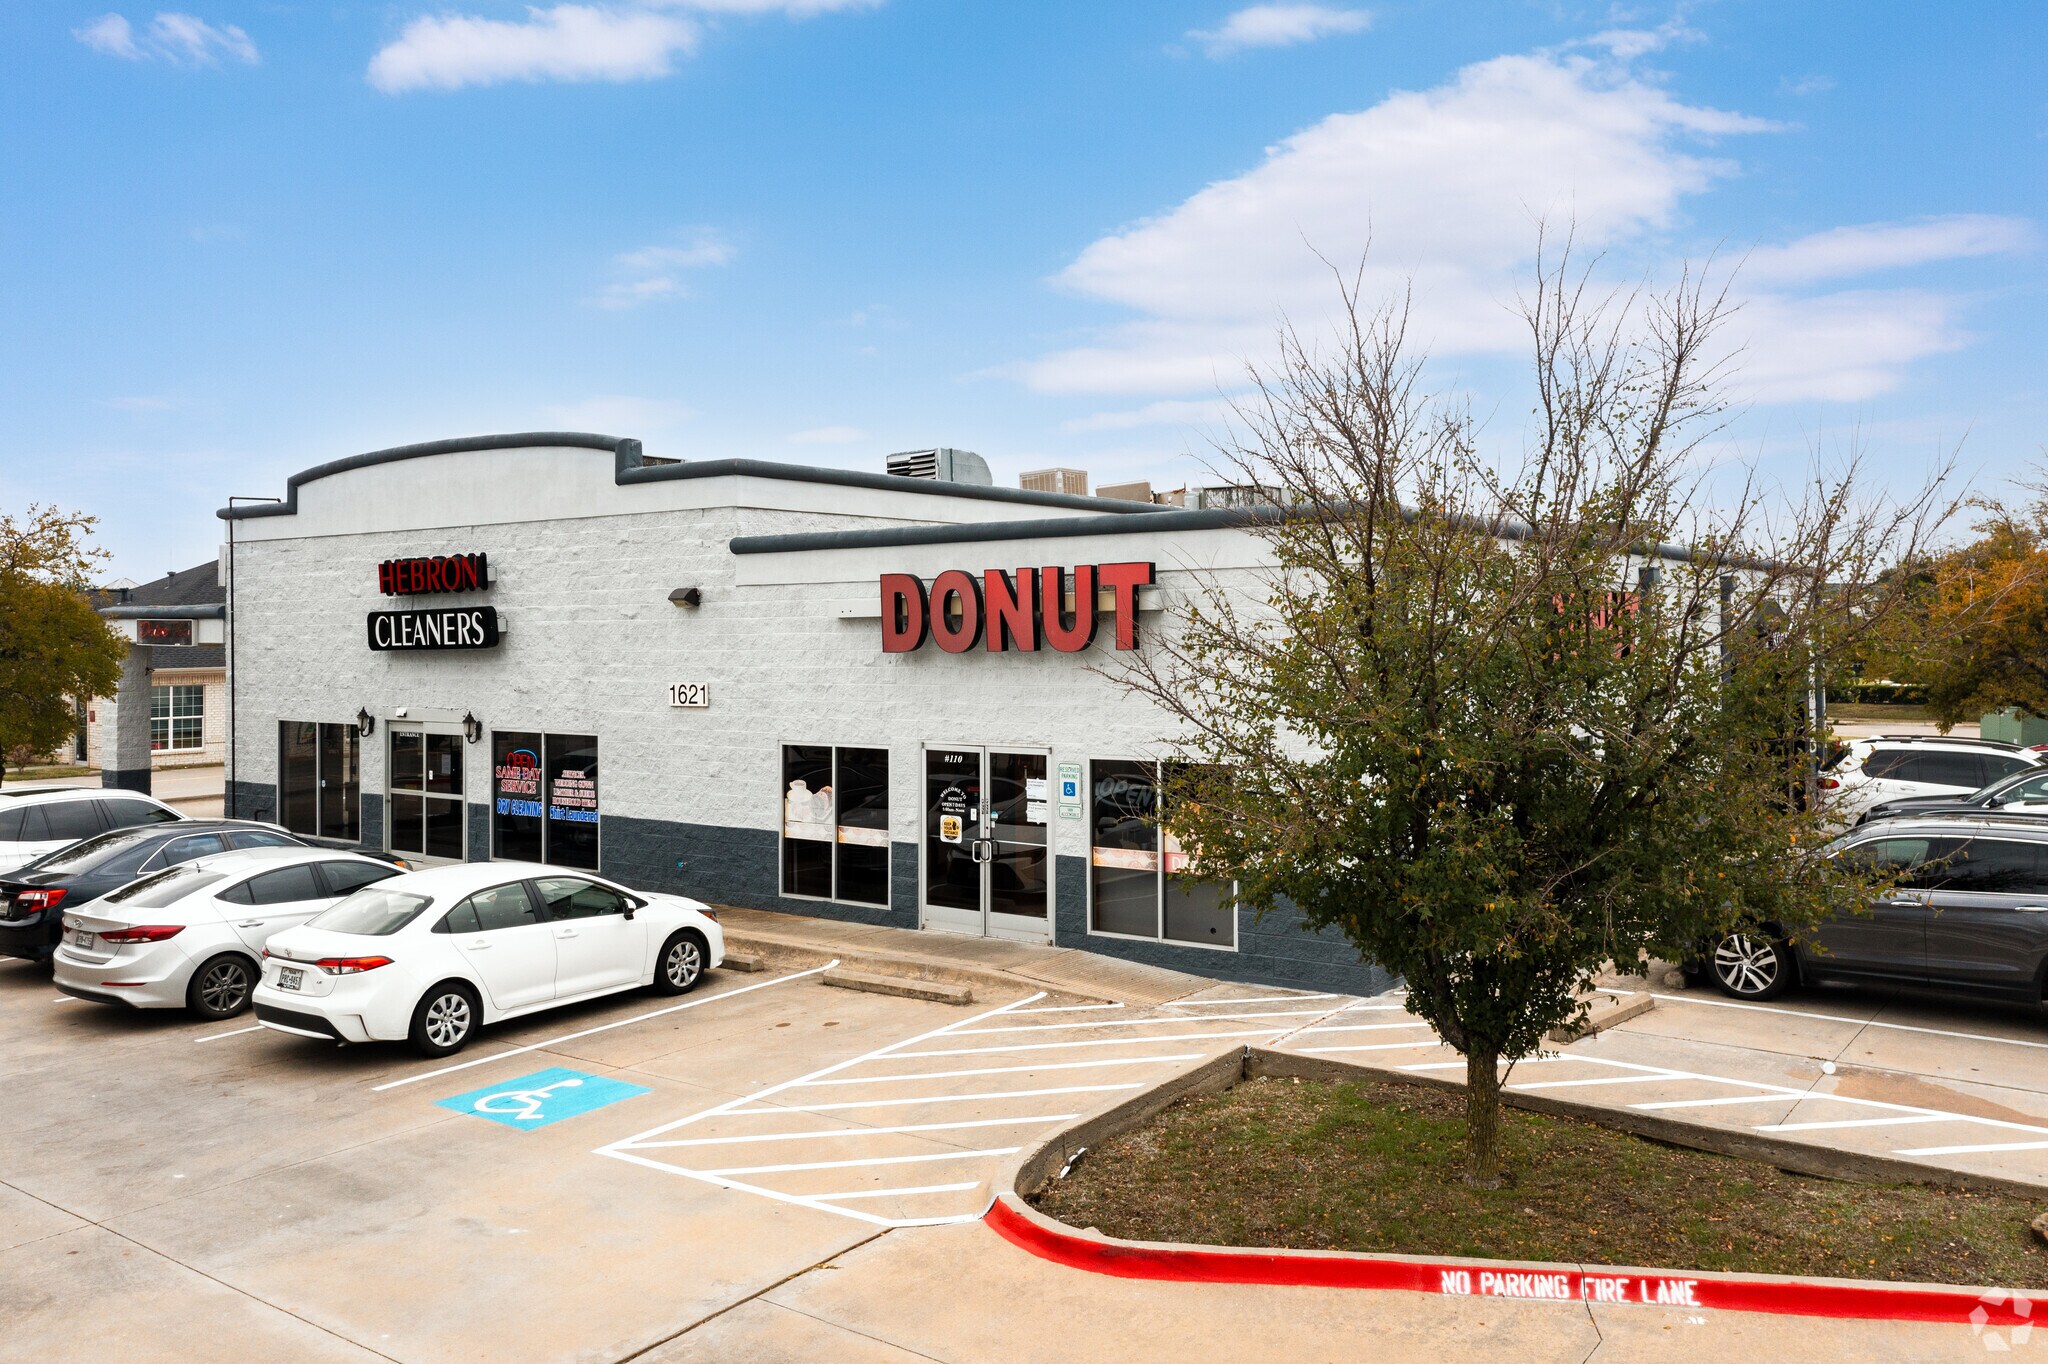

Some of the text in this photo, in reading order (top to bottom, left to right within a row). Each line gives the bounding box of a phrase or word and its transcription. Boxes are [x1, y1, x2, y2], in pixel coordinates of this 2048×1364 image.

[378, 555, 478, 594] HEBRON
[880, 562, 1155, 653] DONUT
[375, 611, 485, 648] CLEANERS
[670, 684, 706, 704] 1621
[496, 766, 541, 780] SAME DAY
[501, 779, 536, 794] SERVICE
[940, 786, 961, 798] WELCOME
[1101, 777, 1154, 808] OPEN
[511, 799, 543, 818] CLEANING
[550, 806, 598, 823] Shirt Laundered
[1441, 1271, 1701, 1306] NO PARKING FIRE LANE
